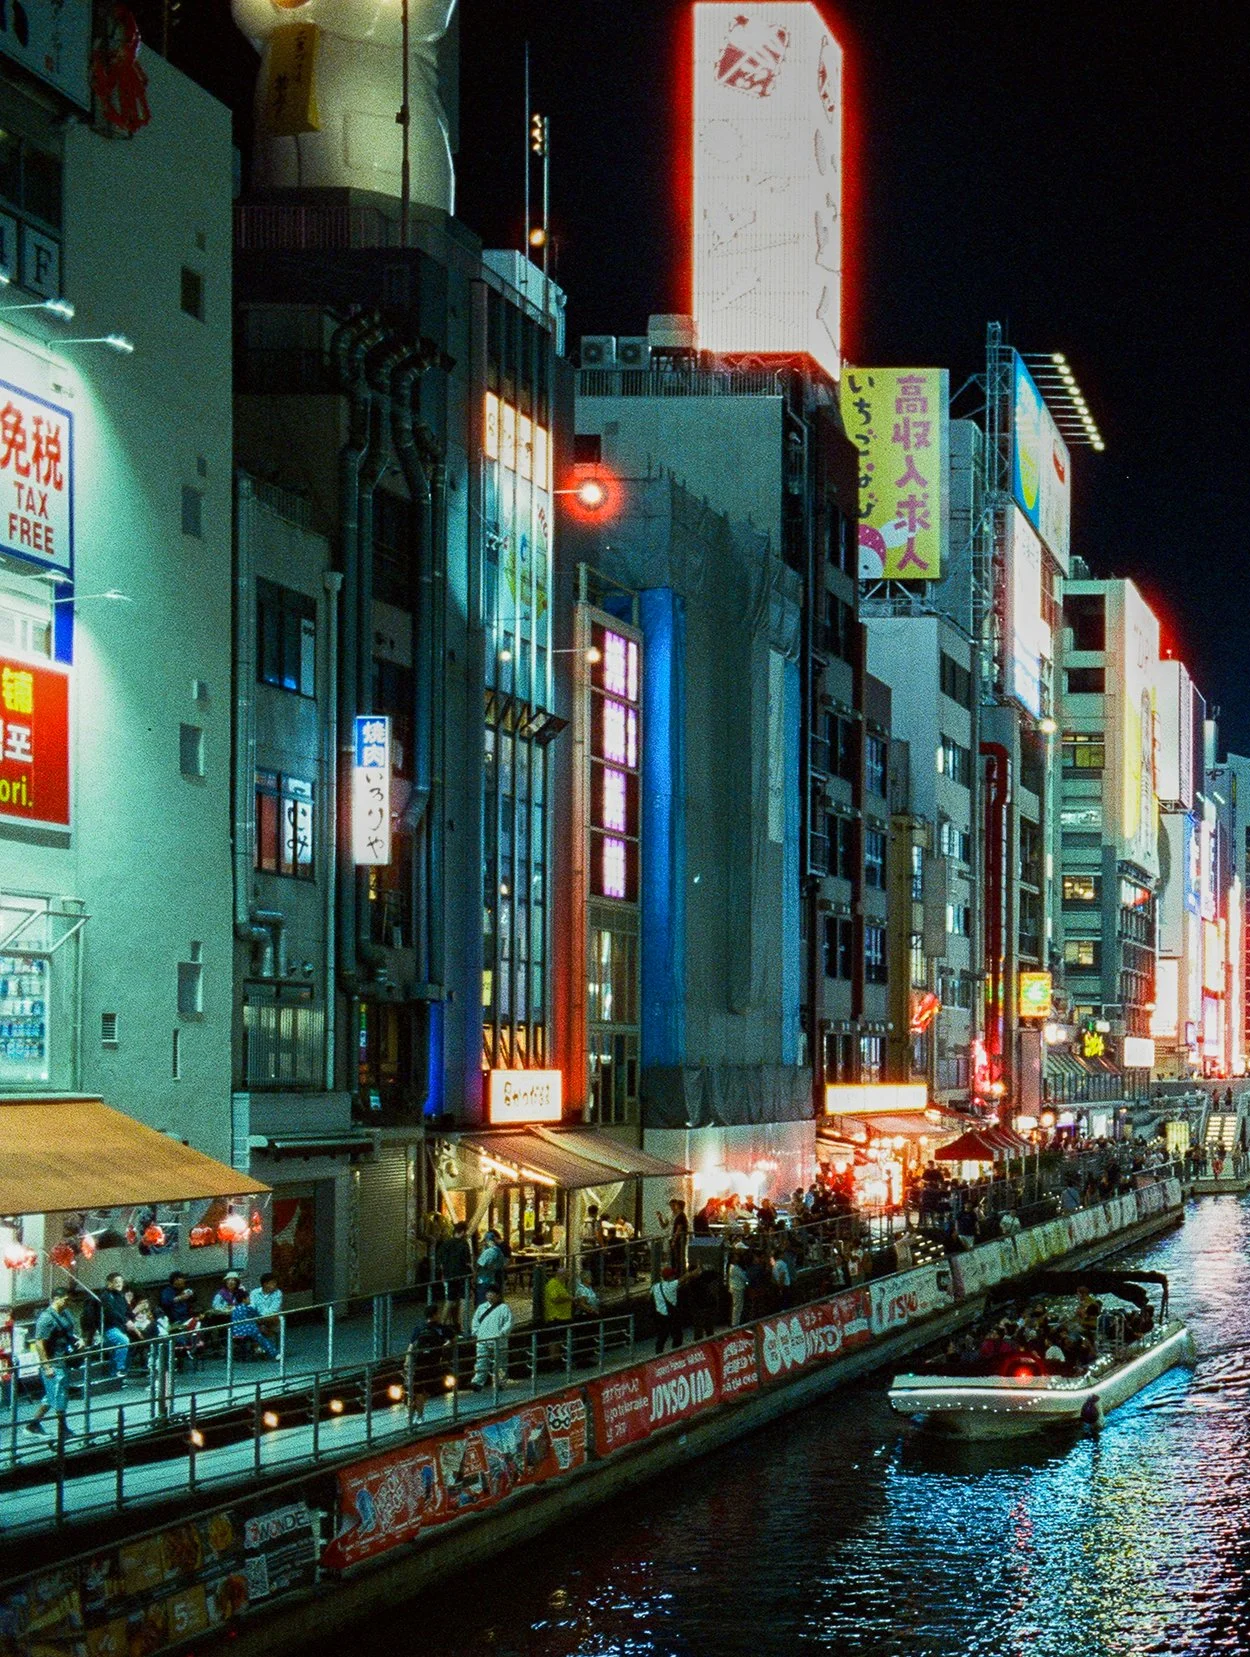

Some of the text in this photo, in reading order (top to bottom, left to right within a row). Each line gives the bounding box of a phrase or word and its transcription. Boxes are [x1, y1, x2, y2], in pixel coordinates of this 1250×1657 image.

[0, 400, 63, 492] 免税
[13, 480, 48, 520] TAX
[8, 512, 55, 555] FREE
[362, 720, 386, 767] 焼肉
[366, 773, 385, 859] いろりや
